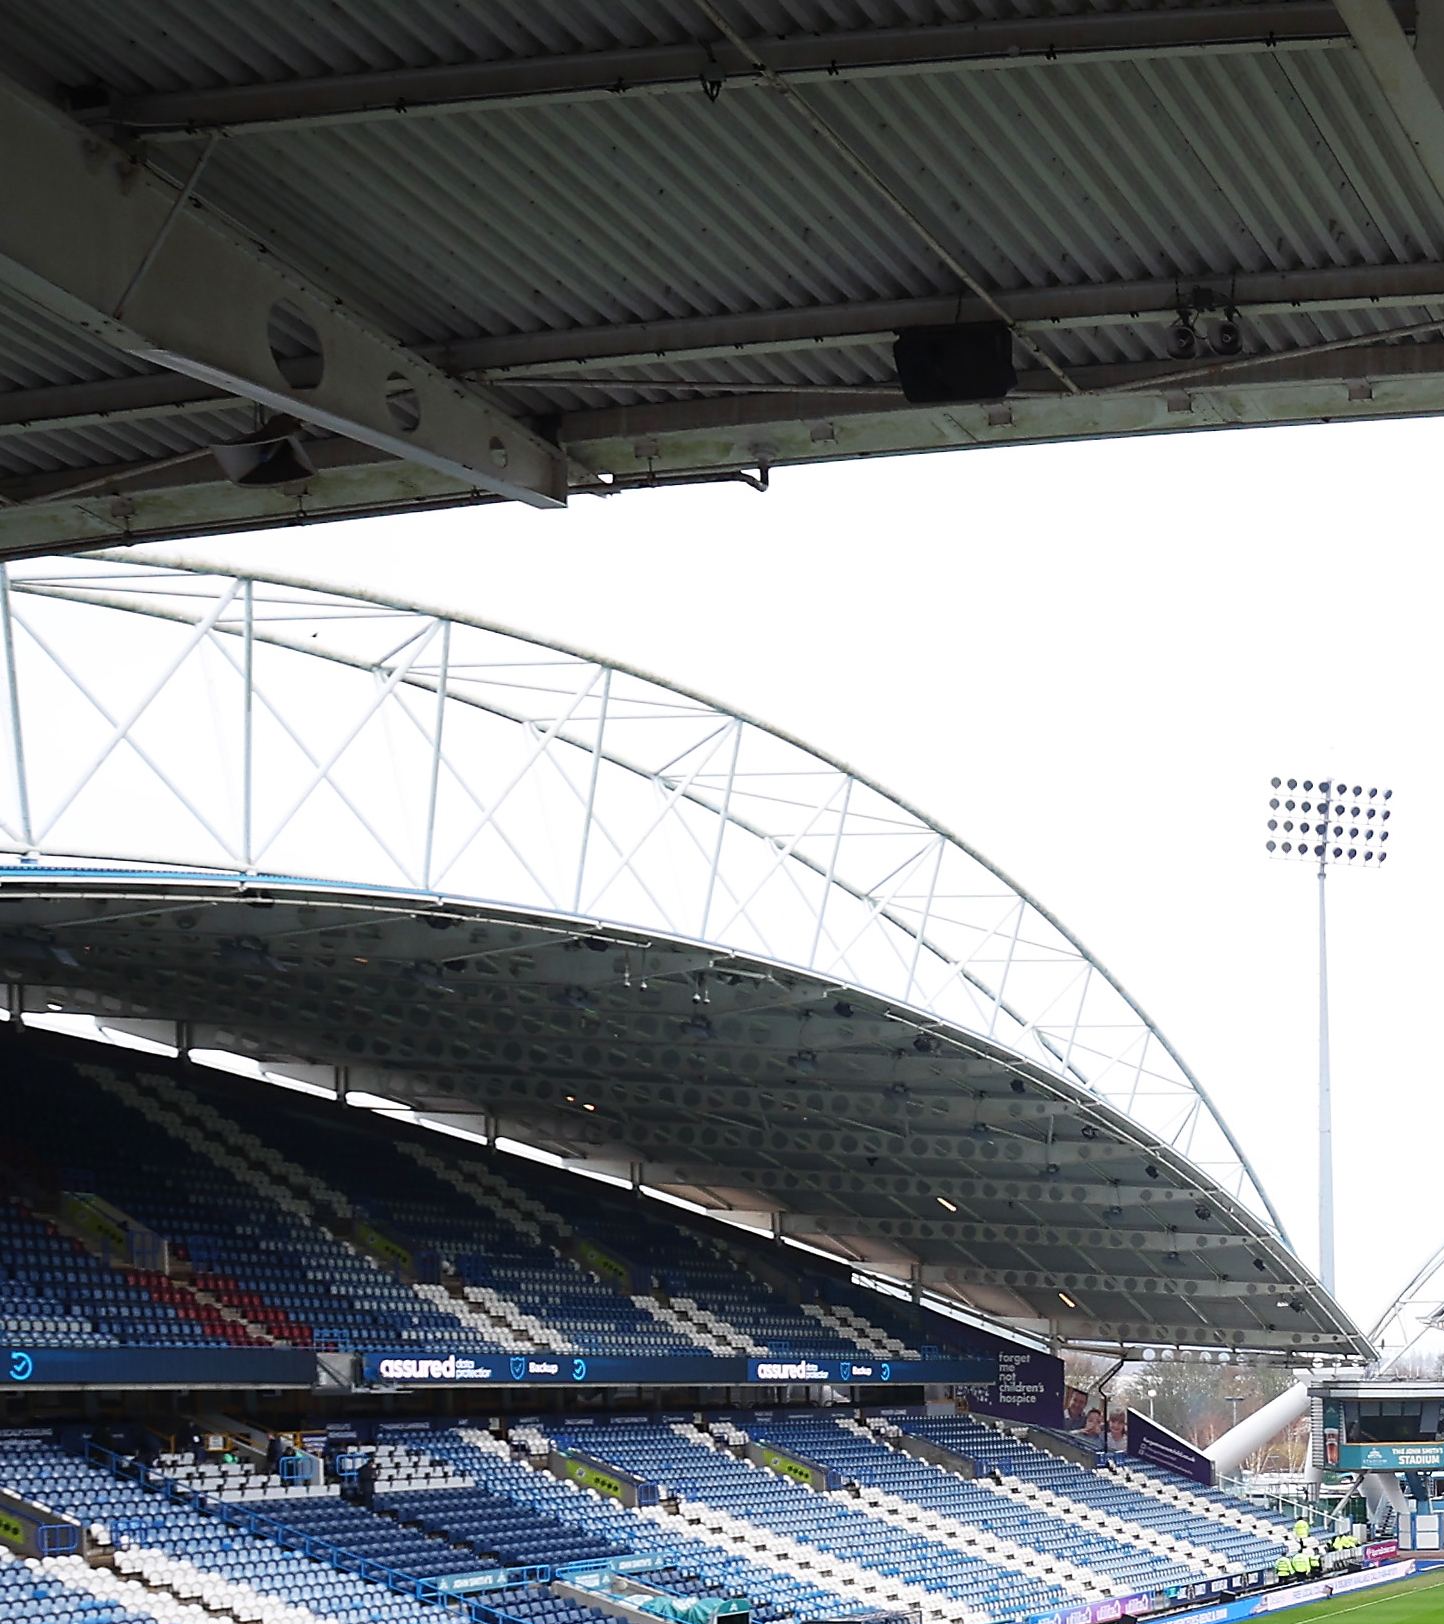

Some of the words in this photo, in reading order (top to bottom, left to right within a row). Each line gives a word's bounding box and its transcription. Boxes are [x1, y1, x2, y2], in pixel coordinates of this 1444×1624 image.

[999, 1352, 1030, 1365] forget
[380, 1355, 455, 1379] assured
[757, 1360, 806, 1379] assured
[1000, 1364, 1015, 1372] me
[1000, 1372, 1016, 1382] not
[1000, 1382, 1044, 1393] children's
[1000, 1393, 1037, 1404] hospice
[1399, 1455, 1440, 1465] STADIUM
